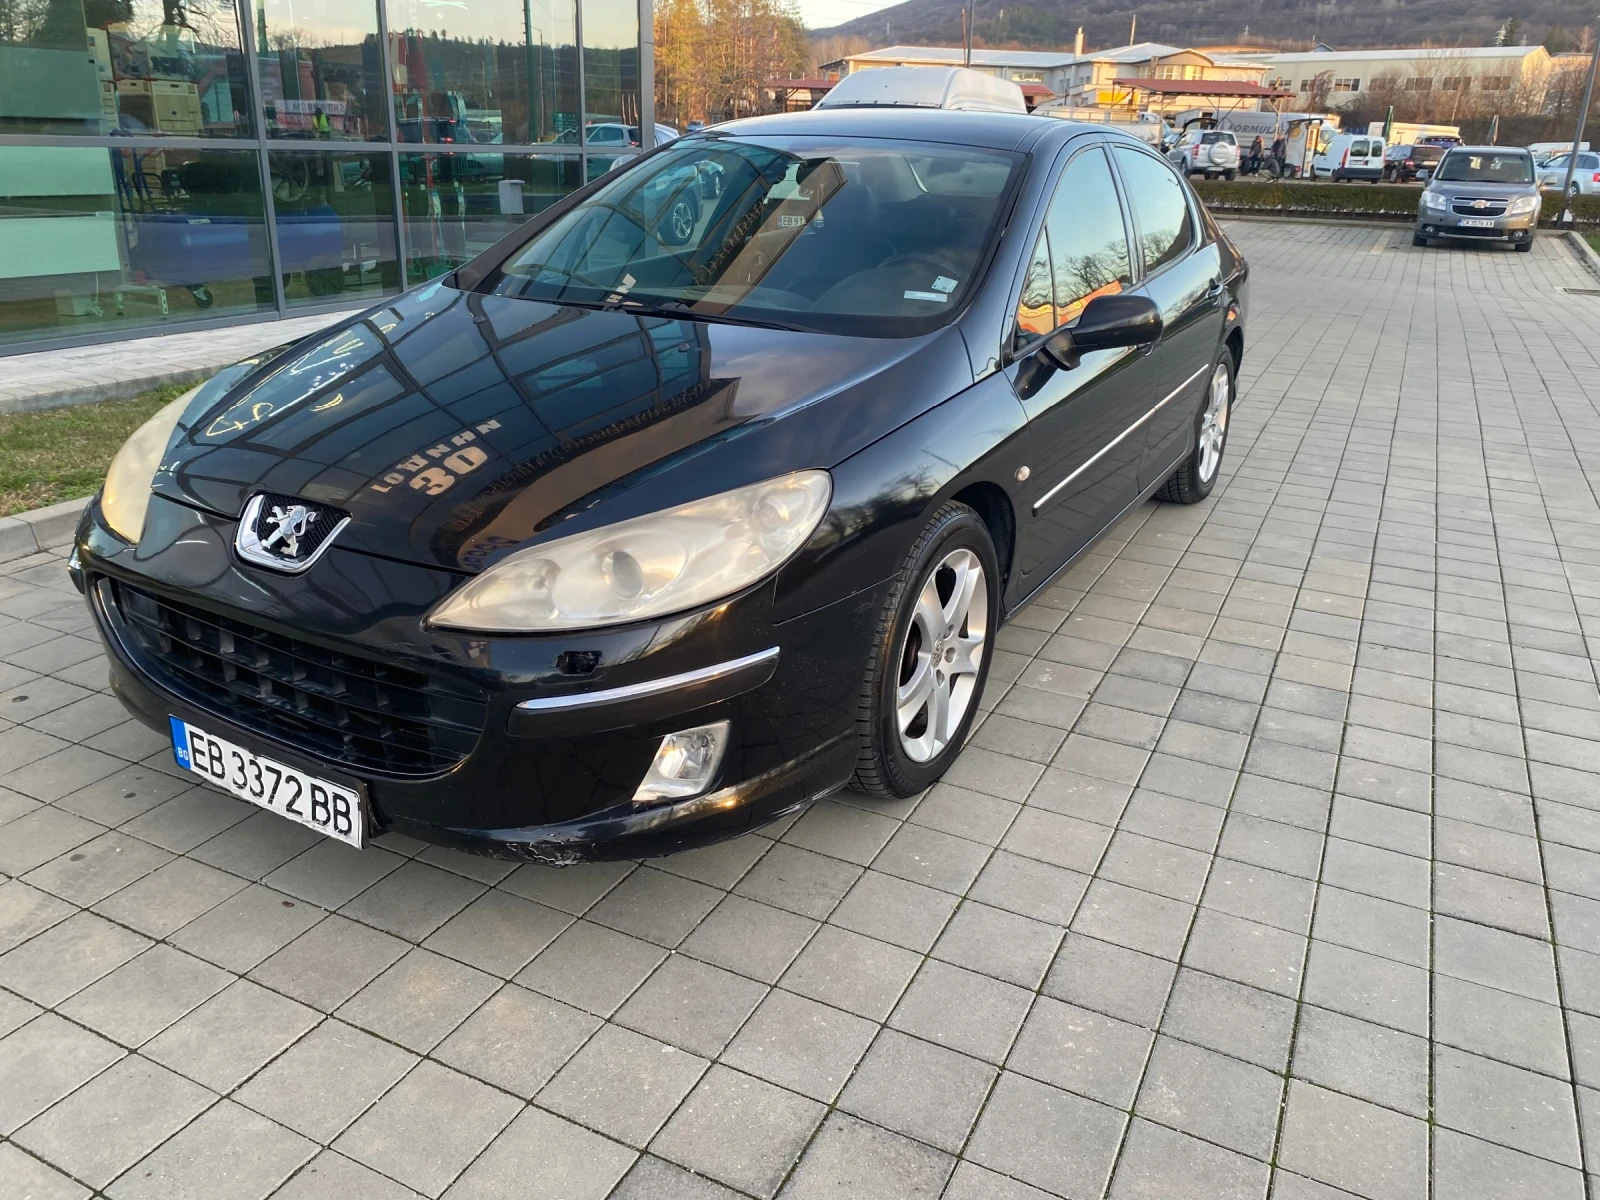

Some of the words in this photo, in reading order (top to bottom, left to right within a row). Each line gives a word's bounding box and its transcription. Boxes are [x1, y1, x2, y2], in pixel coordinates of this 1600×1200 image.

[177, 746, 189, 761] BG
[189, 730, 226, 780] EB
[231, 751, 304, 816] 3372
[310, 782, 353, 836] BB
